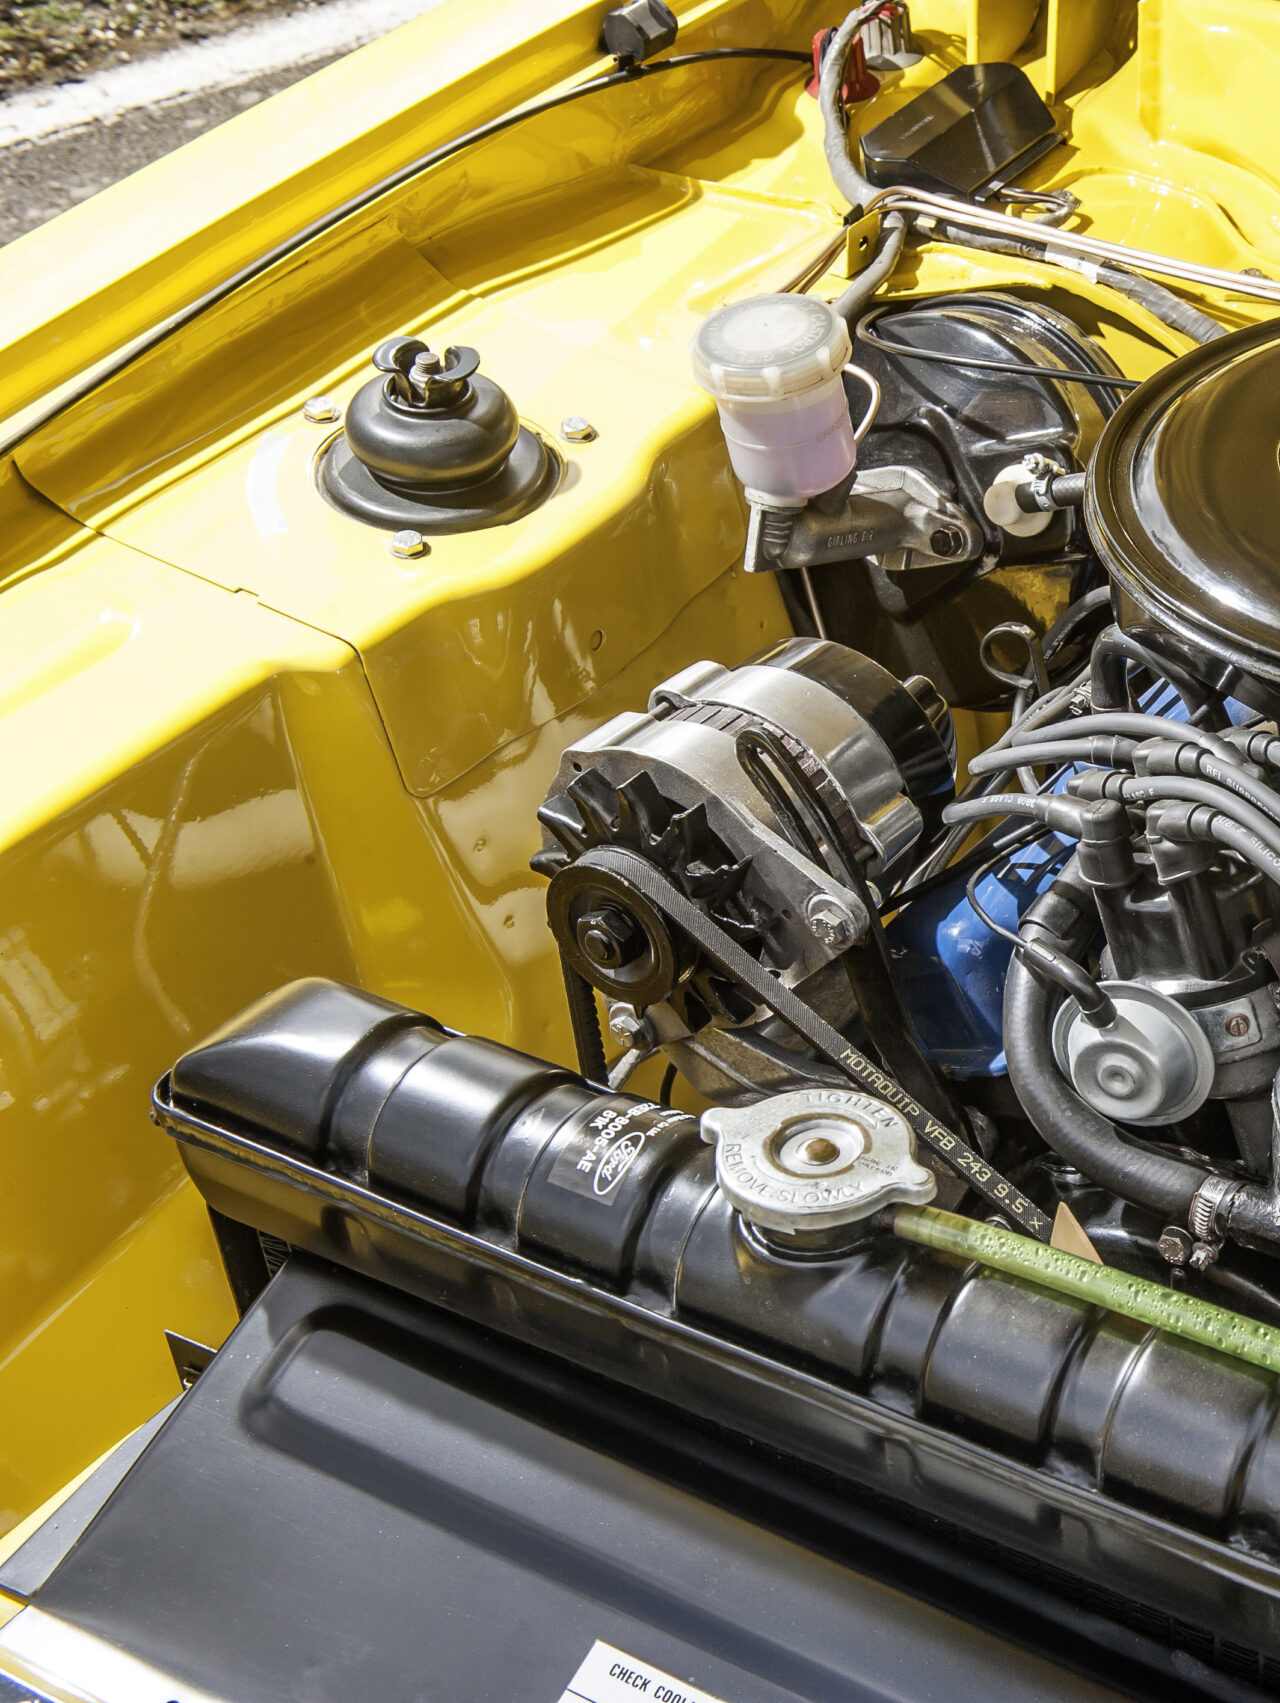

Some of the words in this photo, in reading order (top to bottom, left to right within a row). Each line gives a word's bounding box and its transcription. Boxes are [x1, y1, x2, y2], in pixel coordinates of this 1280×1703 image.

[1206, 764, 1222, 779] RFI
[803, 1091, 900, 1129] TIGHTEN
[840, 1048, 920, 1117] MOTAQUIP
[923, 1118, 956, 1151] VFB
[957, 1151, 992, 1183] 243
[993, 1183, 1029, 1214] 9.5
[725, 1142, 772, 1197] REMOVE
[775, 1180, 865, 1204] SLOWLY
[608, 1662, 653, 1692] CHECK
